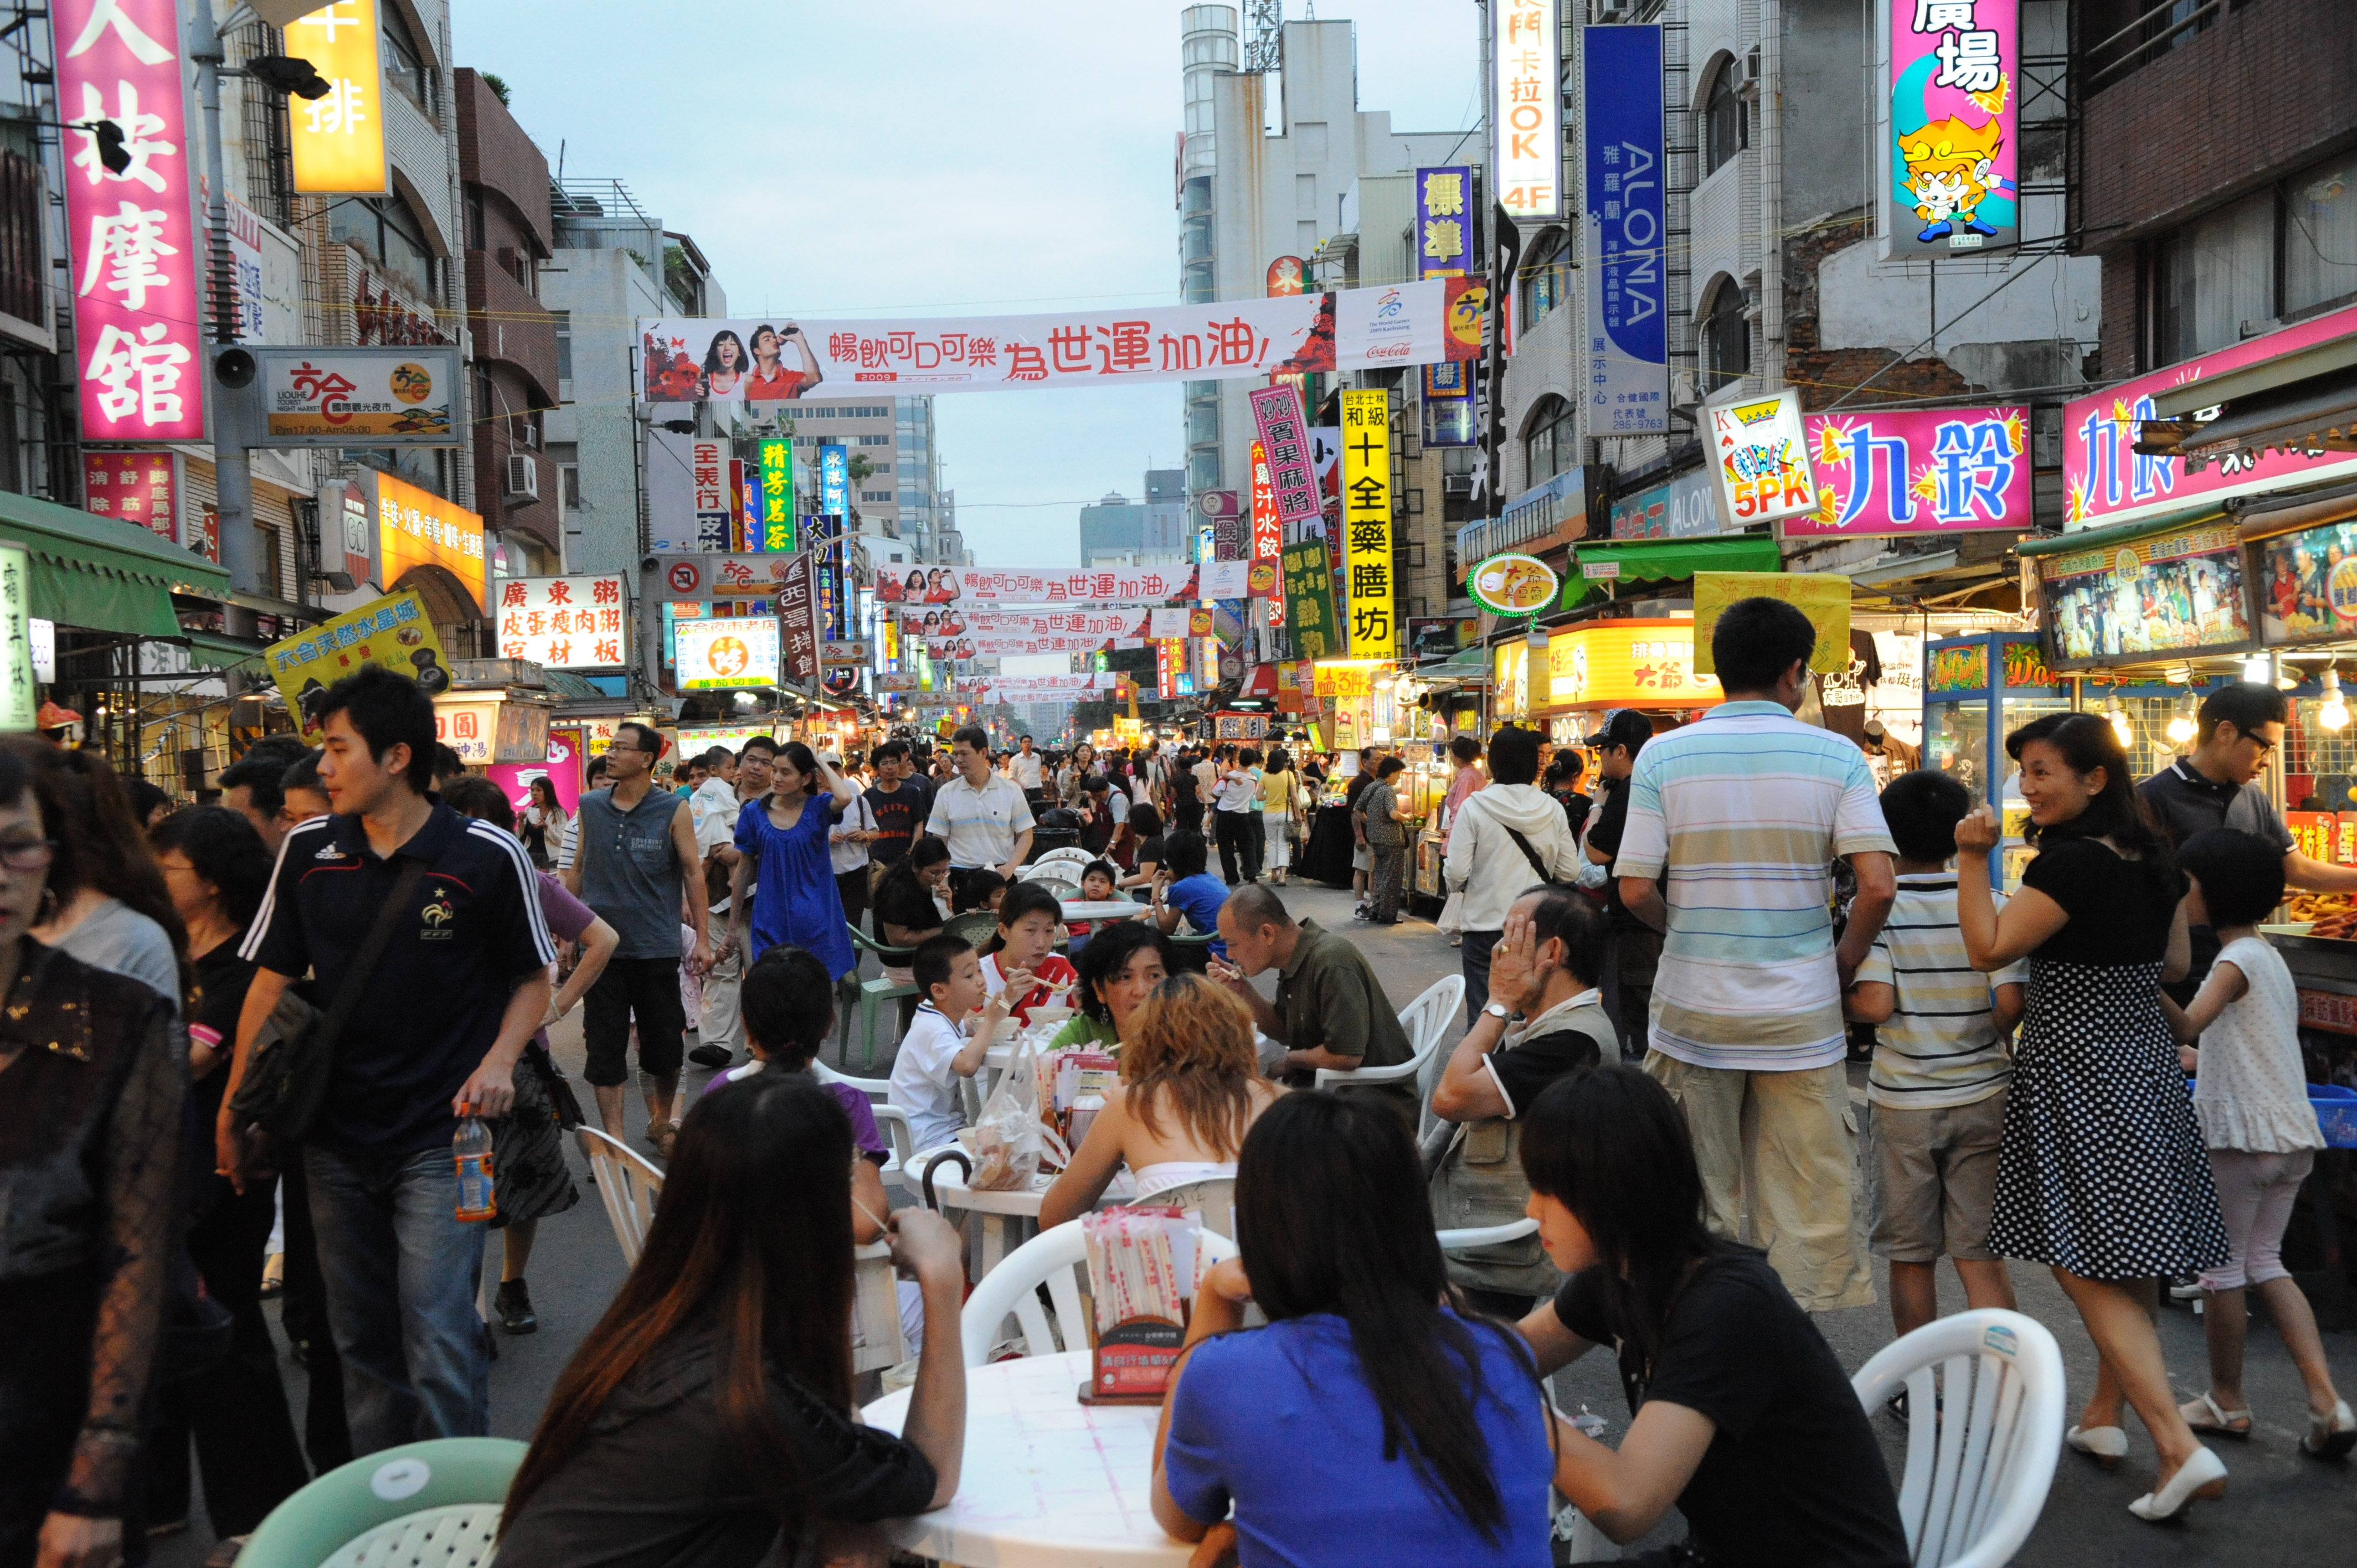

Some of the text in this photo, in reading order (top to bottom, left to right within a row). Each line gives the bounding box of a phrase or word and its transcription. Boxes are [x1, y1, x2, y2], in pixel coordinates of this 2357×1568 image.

[1509, 0, 1546, 159] 門卡拉OK
[1504, 186, 1551, 209] 4F
[1604, 146, 1620, 220] 雅羅蘭
[1424, 173, 1463, 263] 標準
[1622, 141, 1657, 326] ALONA
[1607, 241, 1619, 327] 薄型液晶顯示器
[830, 317, 1269, 381] 暢飲可口可樂 為世運加油!
[1593, 338, 1607, 405] 展示中心
[332, 403, 391, 412] 國際觀光夜市
[1260, 395, 1291, 421] 妙妙
[1345, 394, 1385, 405] 台北士林
[1617, 392, 1660, 403] 合健國際
[1613, 408, 1645, 419] 代表號
[1613, 419, 1662, 430] 286-9763
[694, 444, 719, 509] 全美行
[1267, 420, 1310, 514] 賓果麻將
[1838, 420, 2016, 528] 九鈴
[763, 443, 789, 549] 精芳茗茶
[1735, 470, 1809, 517] 5PK
[1672, 486, 1716, 533] ALON
[1349, 432, 1388, 641] 十全藥膳坊
[965, 573, 1170, 600] 暢飲可口可樂 為世運加油!
[1507, 566, 1541, 583] 大爺
[501, 579, 619, 608] 廣東粥
[1504, 585, 1542, 600] 臭豆腐
[274, 599, 419, 672] 六合天然水晶城
[502, 608, 620, 636] 皮蛋瘦肉粥
[676, 620, 777, 635] 六合夜市老店
[969, 613, 1128, 635] 暢飲可口可樂 為世運加油!
[503, 638, 621, 664] 官材板
[1634, 662, 1681, 689] 大爺
